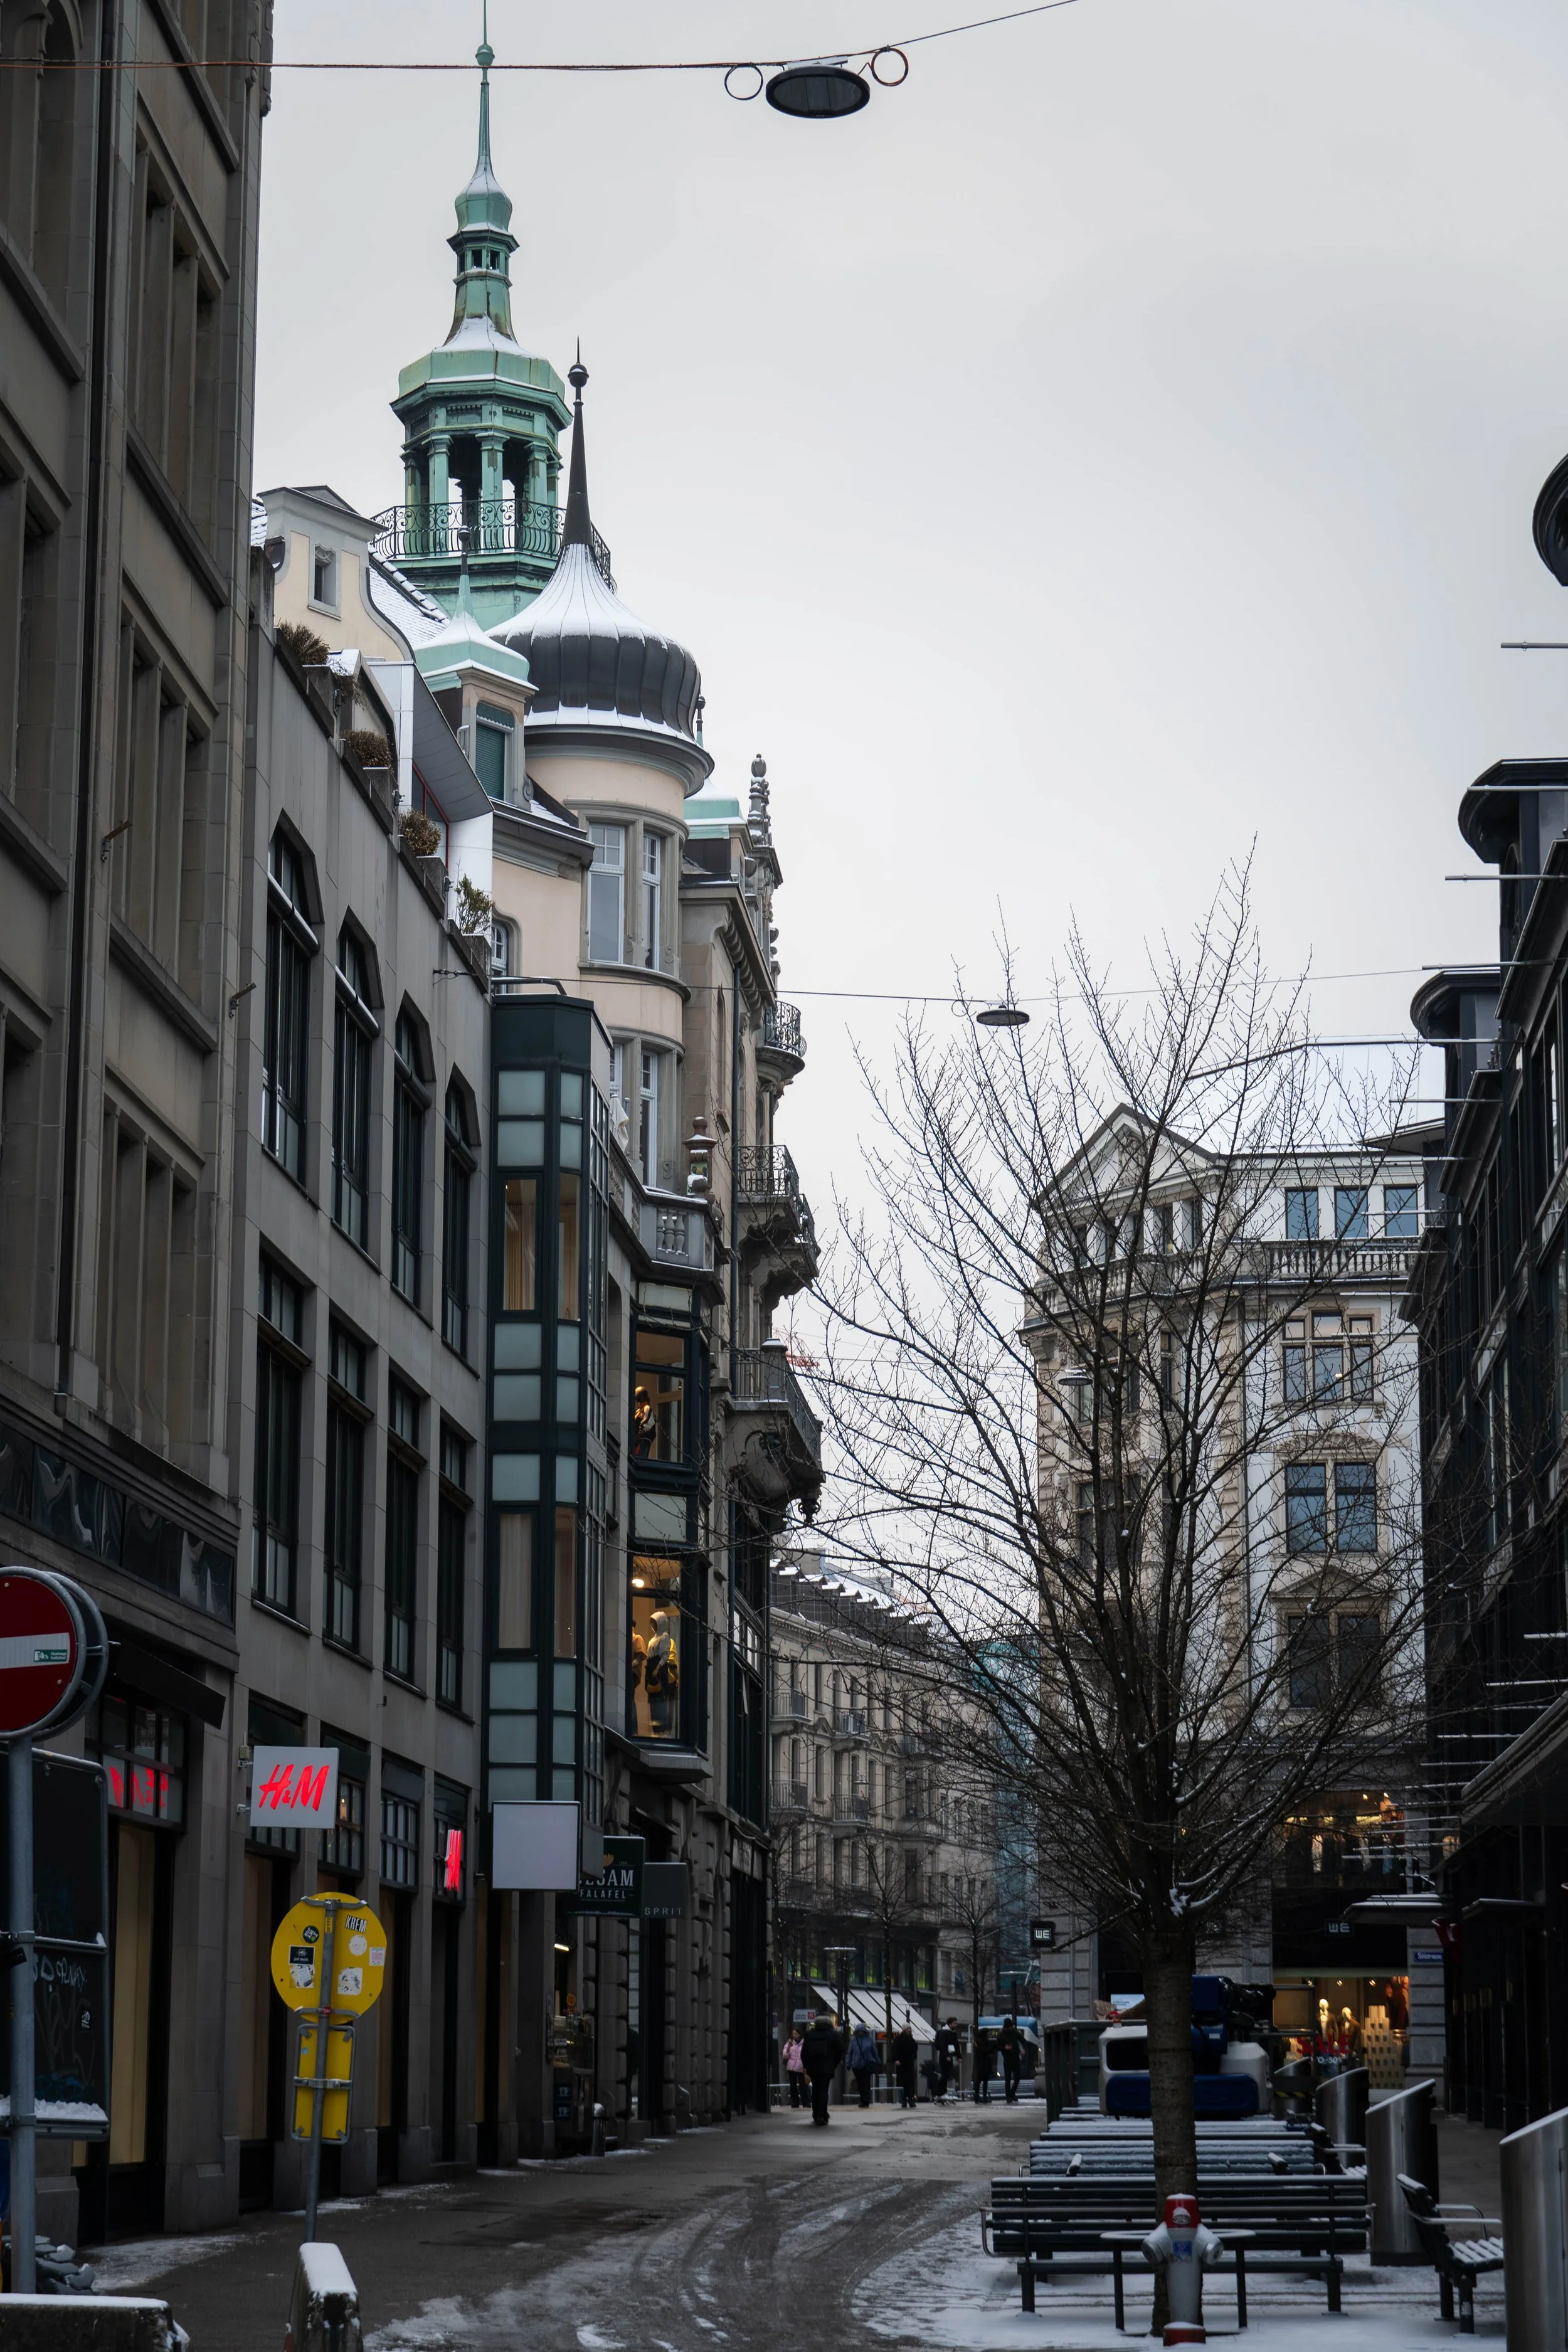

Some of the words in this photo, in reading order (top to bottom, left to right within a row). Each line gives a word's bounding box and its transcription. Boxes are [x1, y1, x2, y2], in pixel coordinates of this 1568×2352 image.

[259, 1764, 329, 1811] H&M
[580, 1889, 626, 1899] FALAFEL
[346, 1915, 368, 1933] KREM
[1328, 1922, 1350, 1933] WE
[1035, 1929, 1050, 1939] WE
[1296, 2033, 1350, 2055] SALE
